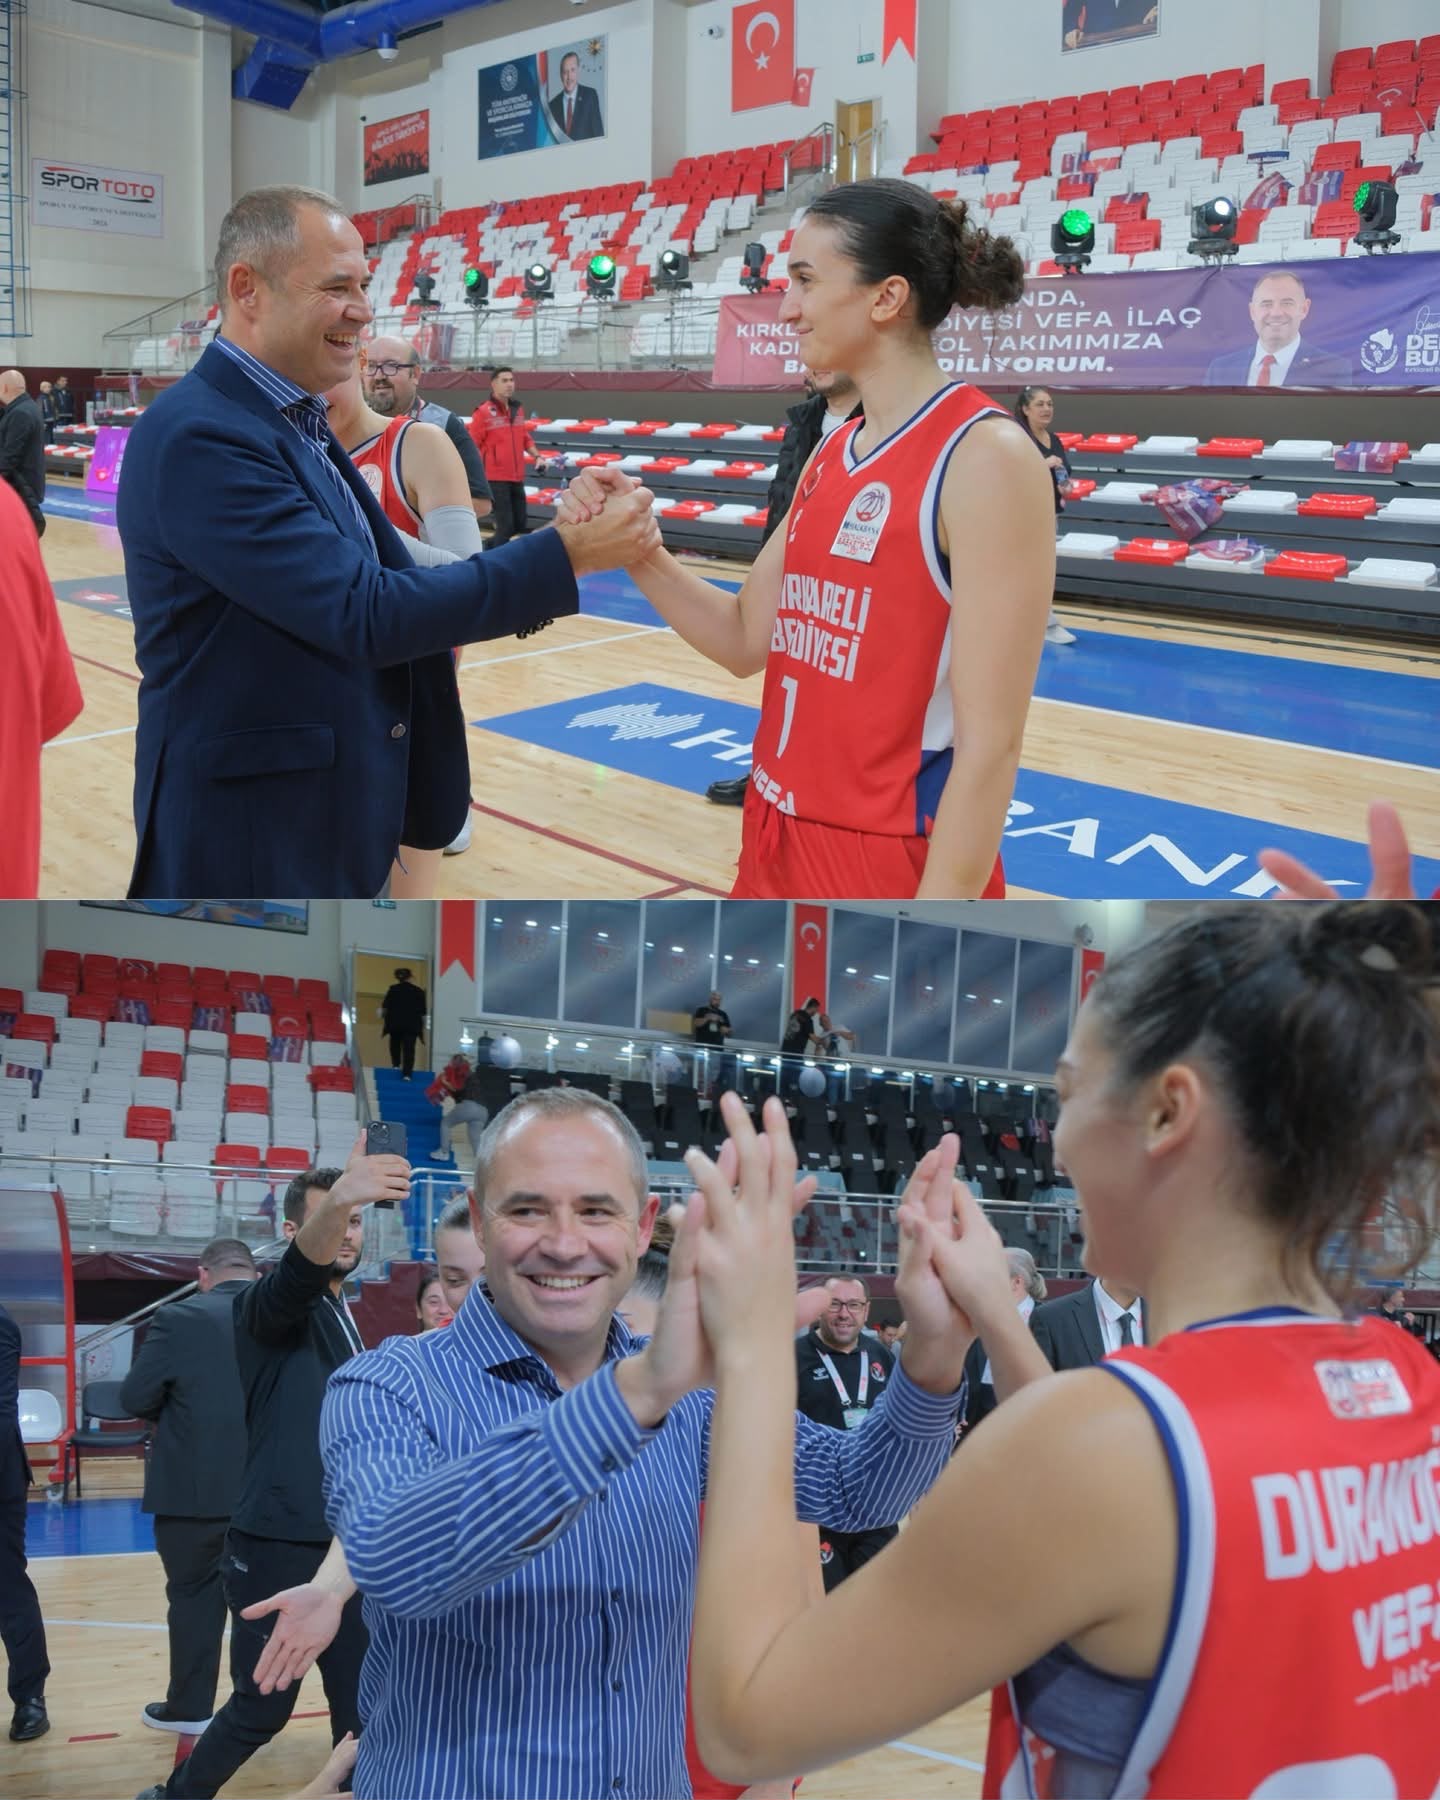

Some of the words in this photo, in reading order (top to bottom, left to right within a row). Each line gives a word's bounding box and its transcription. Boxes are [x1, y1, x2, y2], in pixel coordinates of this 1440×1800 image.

[1006, 289, 1086, 308] NDA,
[736, 323, 799, 338] KIRKL
[1036, 311, 1113, 329] VEFA
[1127, 306, 1202, 330] İLAÇ
[983, 333, 1164, 353] TAKIMIMIZA
[1407, 334, 1440, 350] DE
[1405, 350, 1440, 367] BU
[669, 728, 753, 766] H
